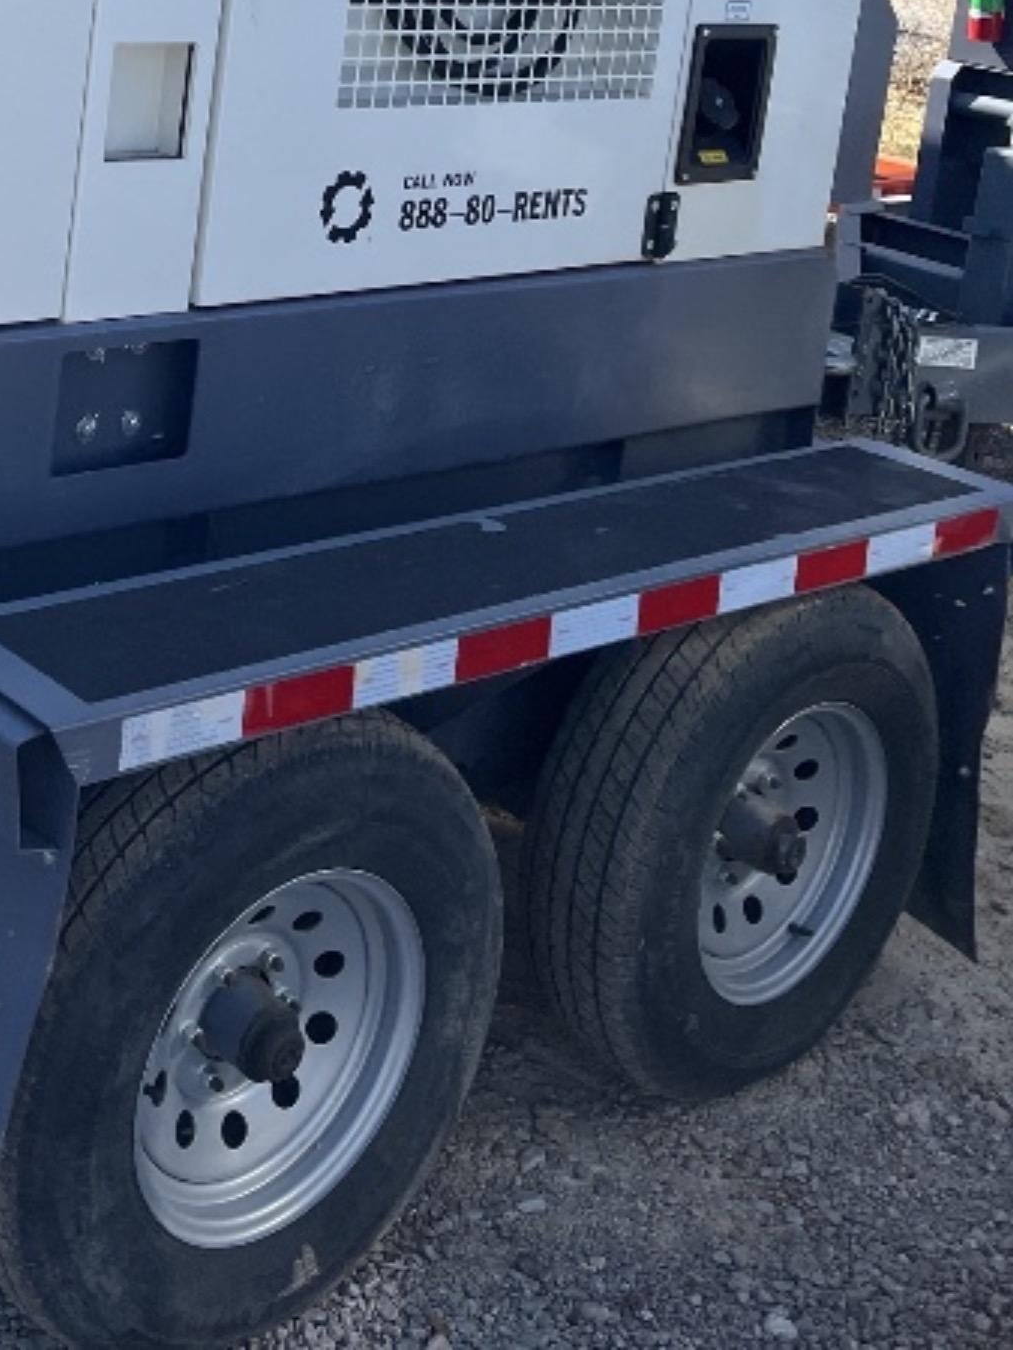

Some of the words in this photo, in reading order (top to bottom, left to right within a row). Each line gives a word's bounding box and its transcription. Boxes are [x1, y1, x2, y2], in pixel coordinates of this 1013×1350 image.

[403, 173, 437, 190] CALL
[442, 171, 476, 188] NOW
[398, 188, 588, 231] 888-80-RENTS
